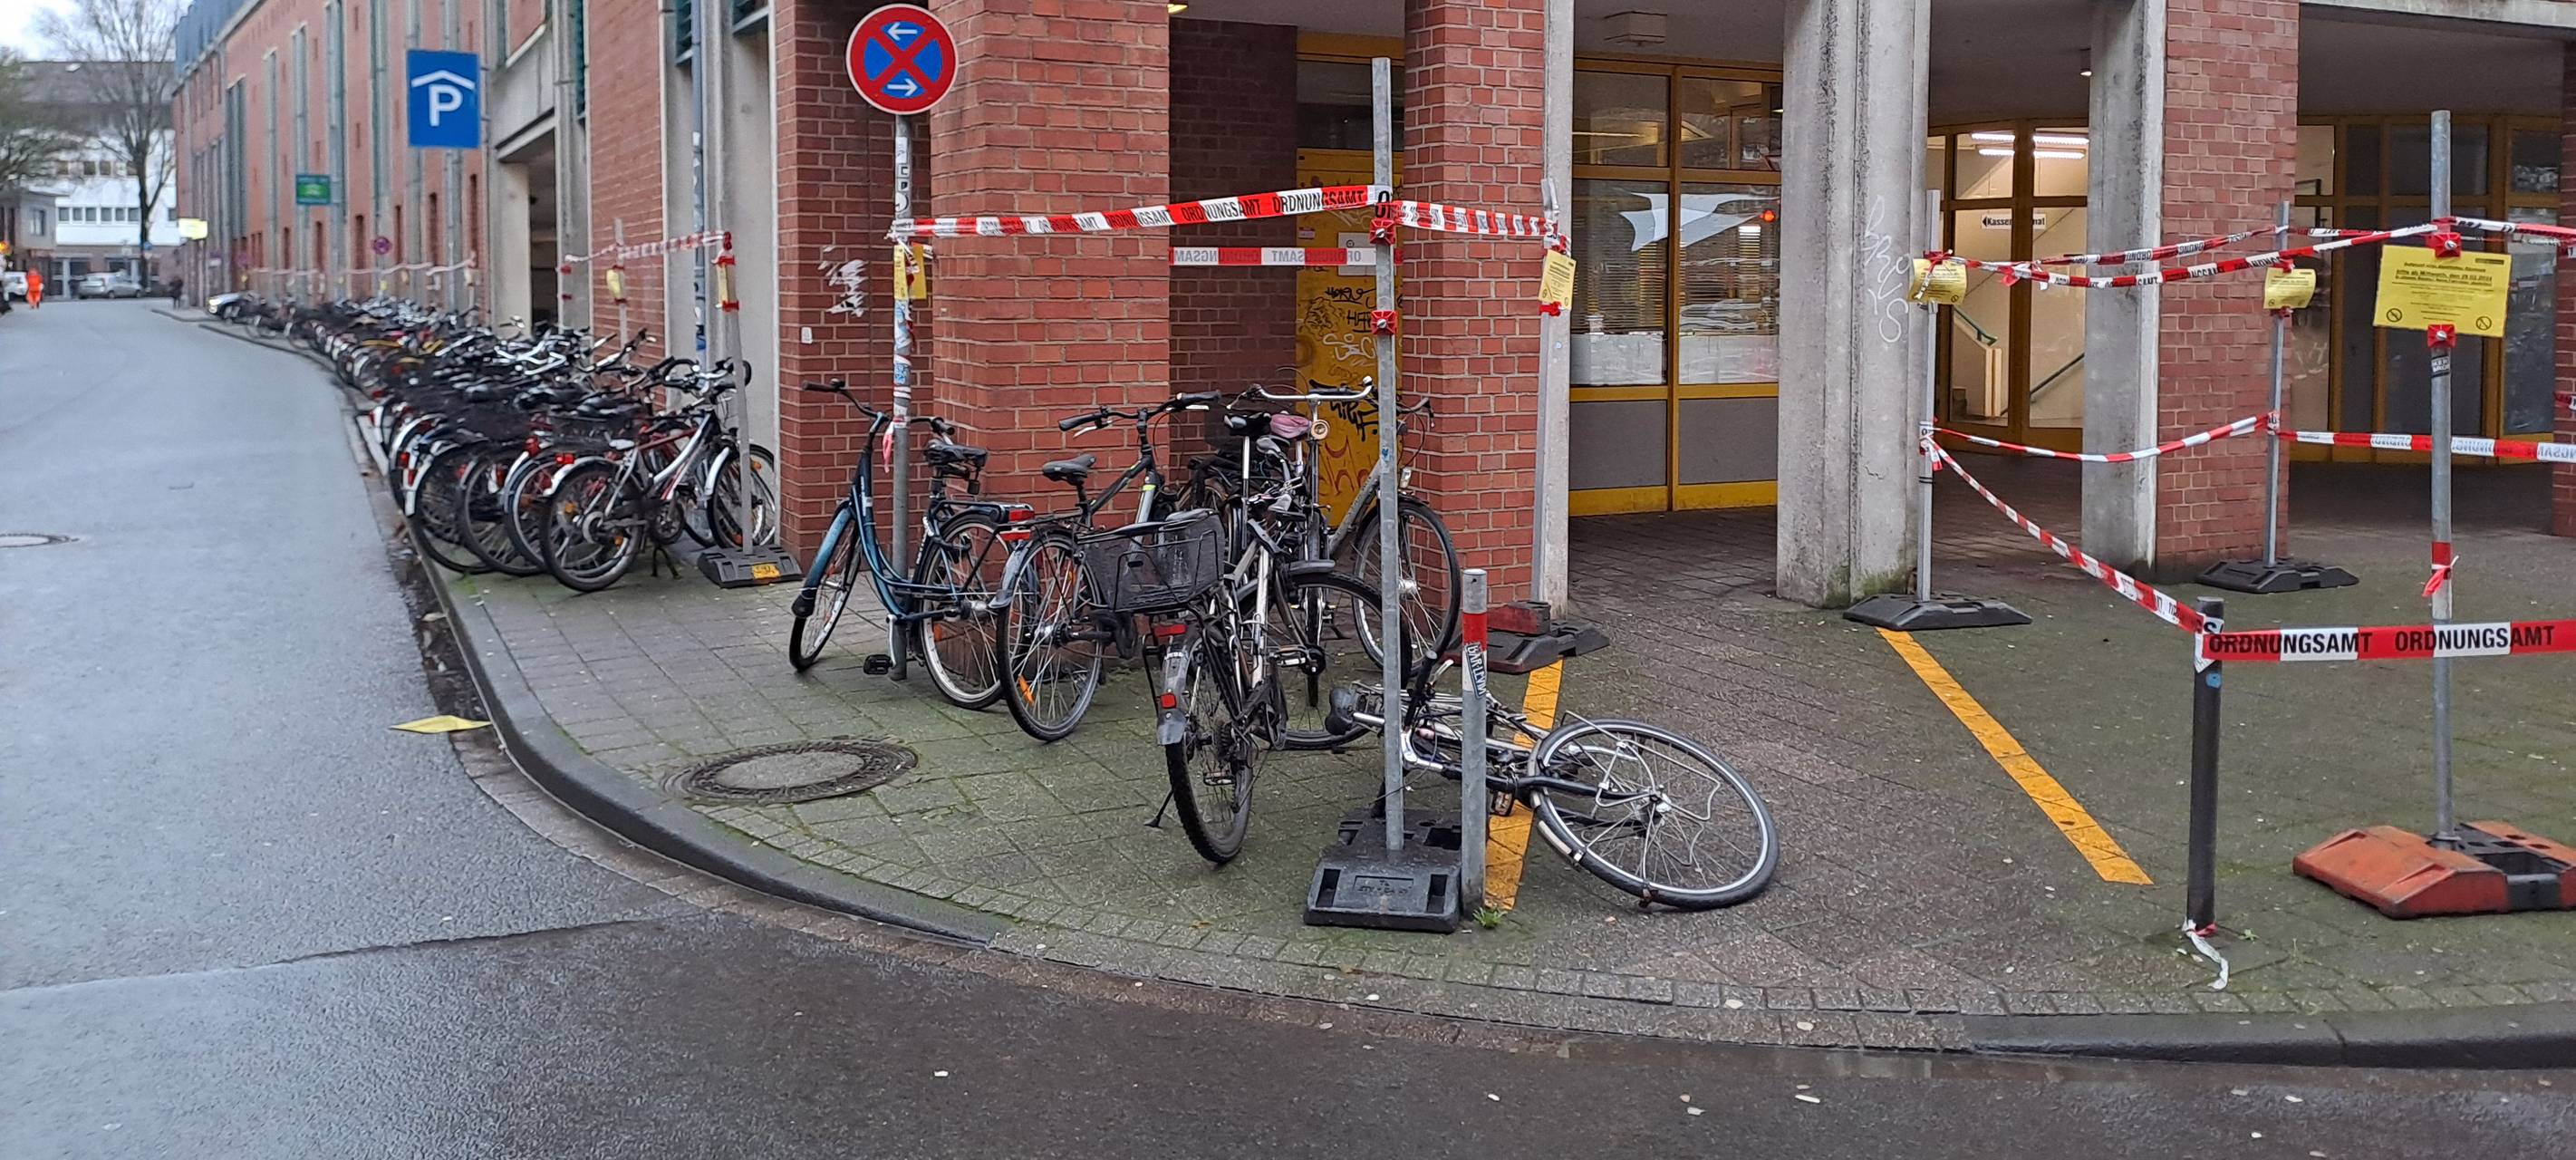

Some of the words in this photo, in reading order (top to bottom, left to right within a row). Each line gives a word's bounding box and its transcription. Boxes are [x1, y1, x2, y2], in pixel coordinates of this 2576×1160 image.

[429, 84, 464, 127] P
[1181, 198, 1262, 223] ORDNUNGSAMT
[1272, 189, 1365, 214] ORDNUNGSAMT
[2208, 632, 2373, 654] ORDNUNGSAMT
[2394, 625, 2555, 652] ORDNUNGSAMT
